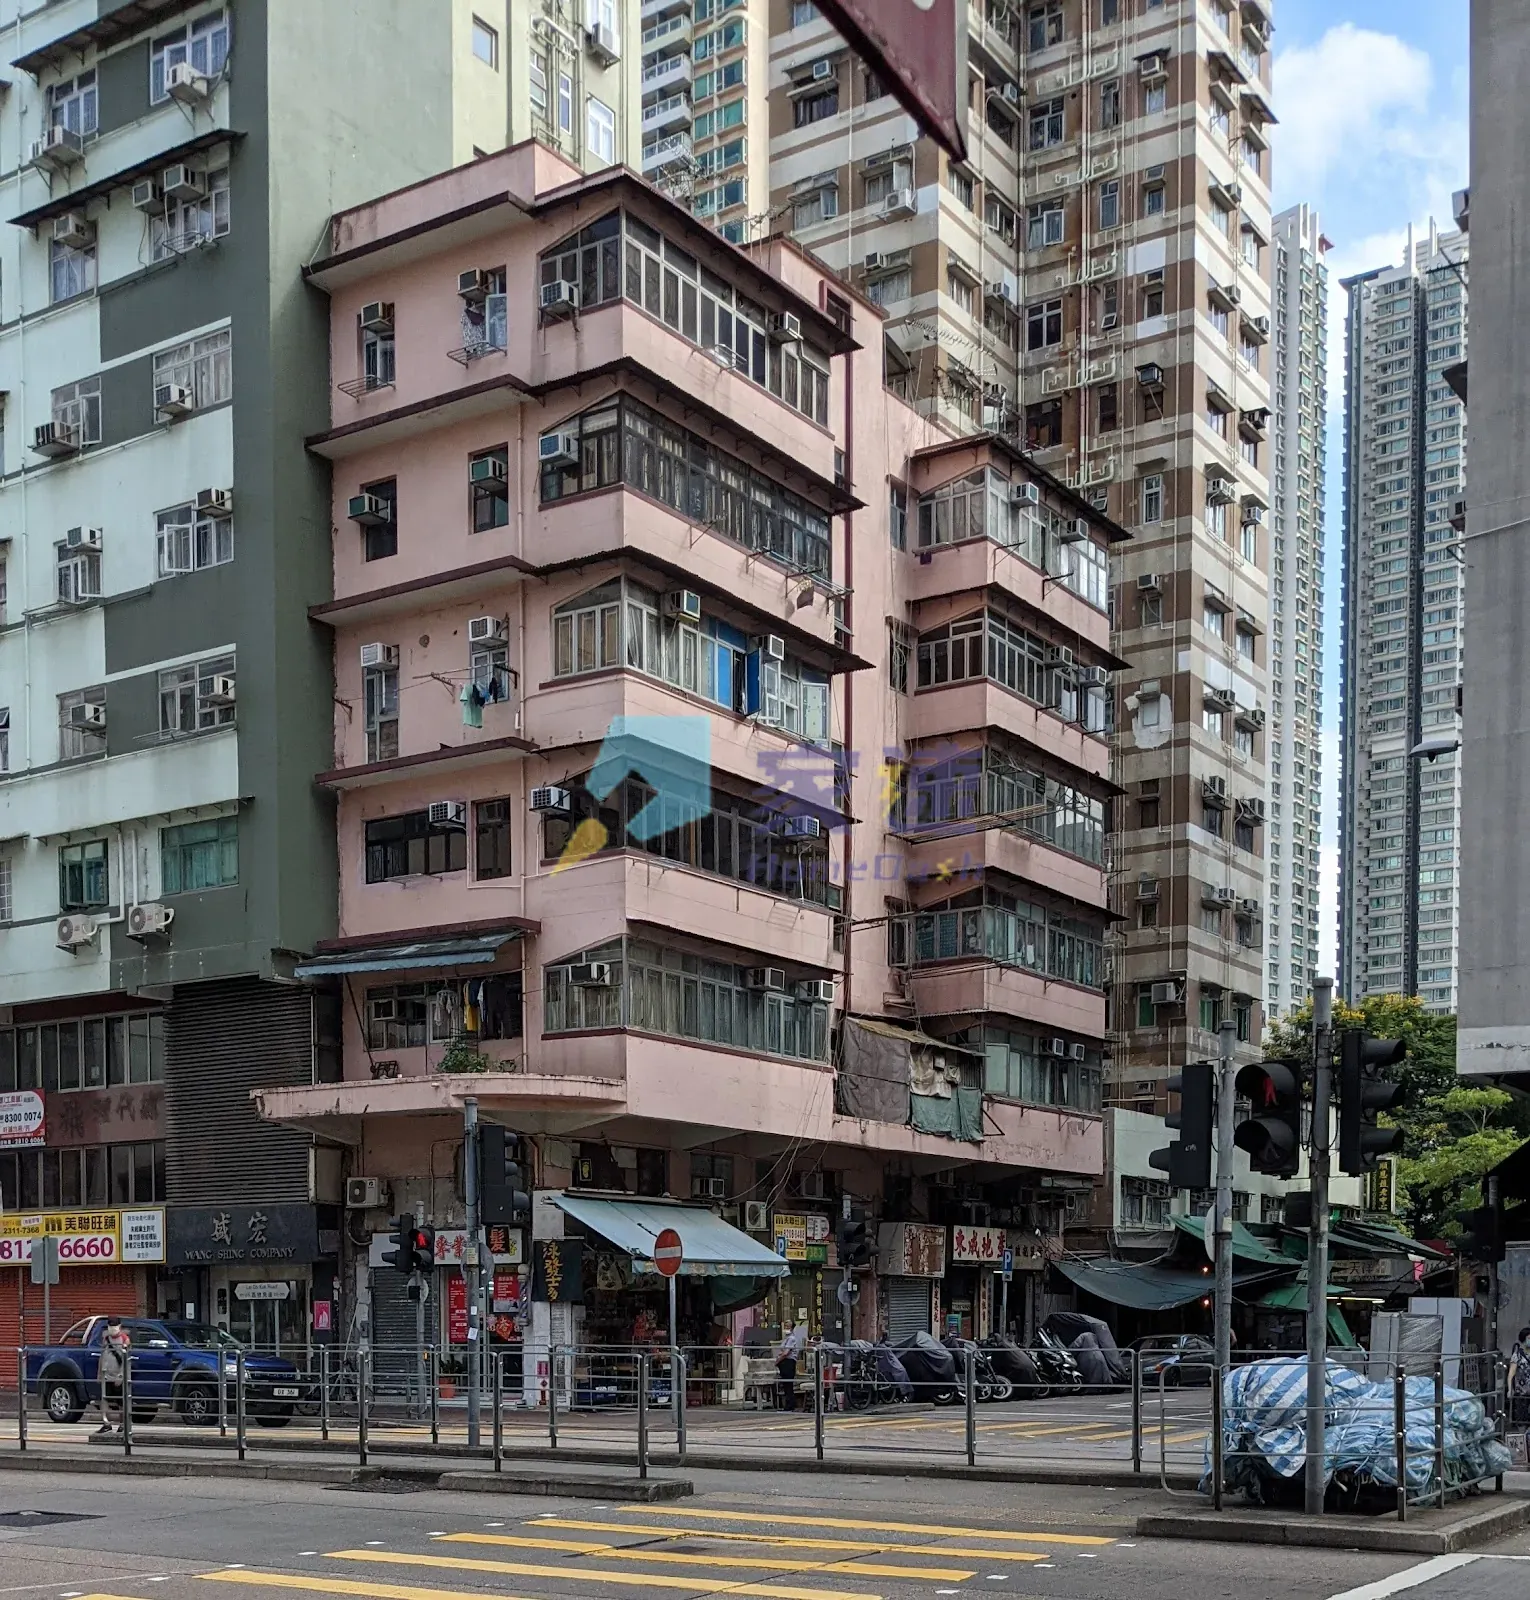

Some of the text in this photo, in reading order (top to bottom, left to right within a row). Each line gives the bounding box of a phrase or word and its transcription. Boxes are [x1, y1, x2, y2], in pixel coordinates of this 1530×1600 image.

[5, 1111, 42, 1123] 8300 0074
[65, 1215, 116, 1231] 美聯旺舖
[490, 1228, 506, 1253] 髮
[184, 1247, 296, 1260] WANG SHING COMPANY
[1004, 1251, 1012, 1269] P
